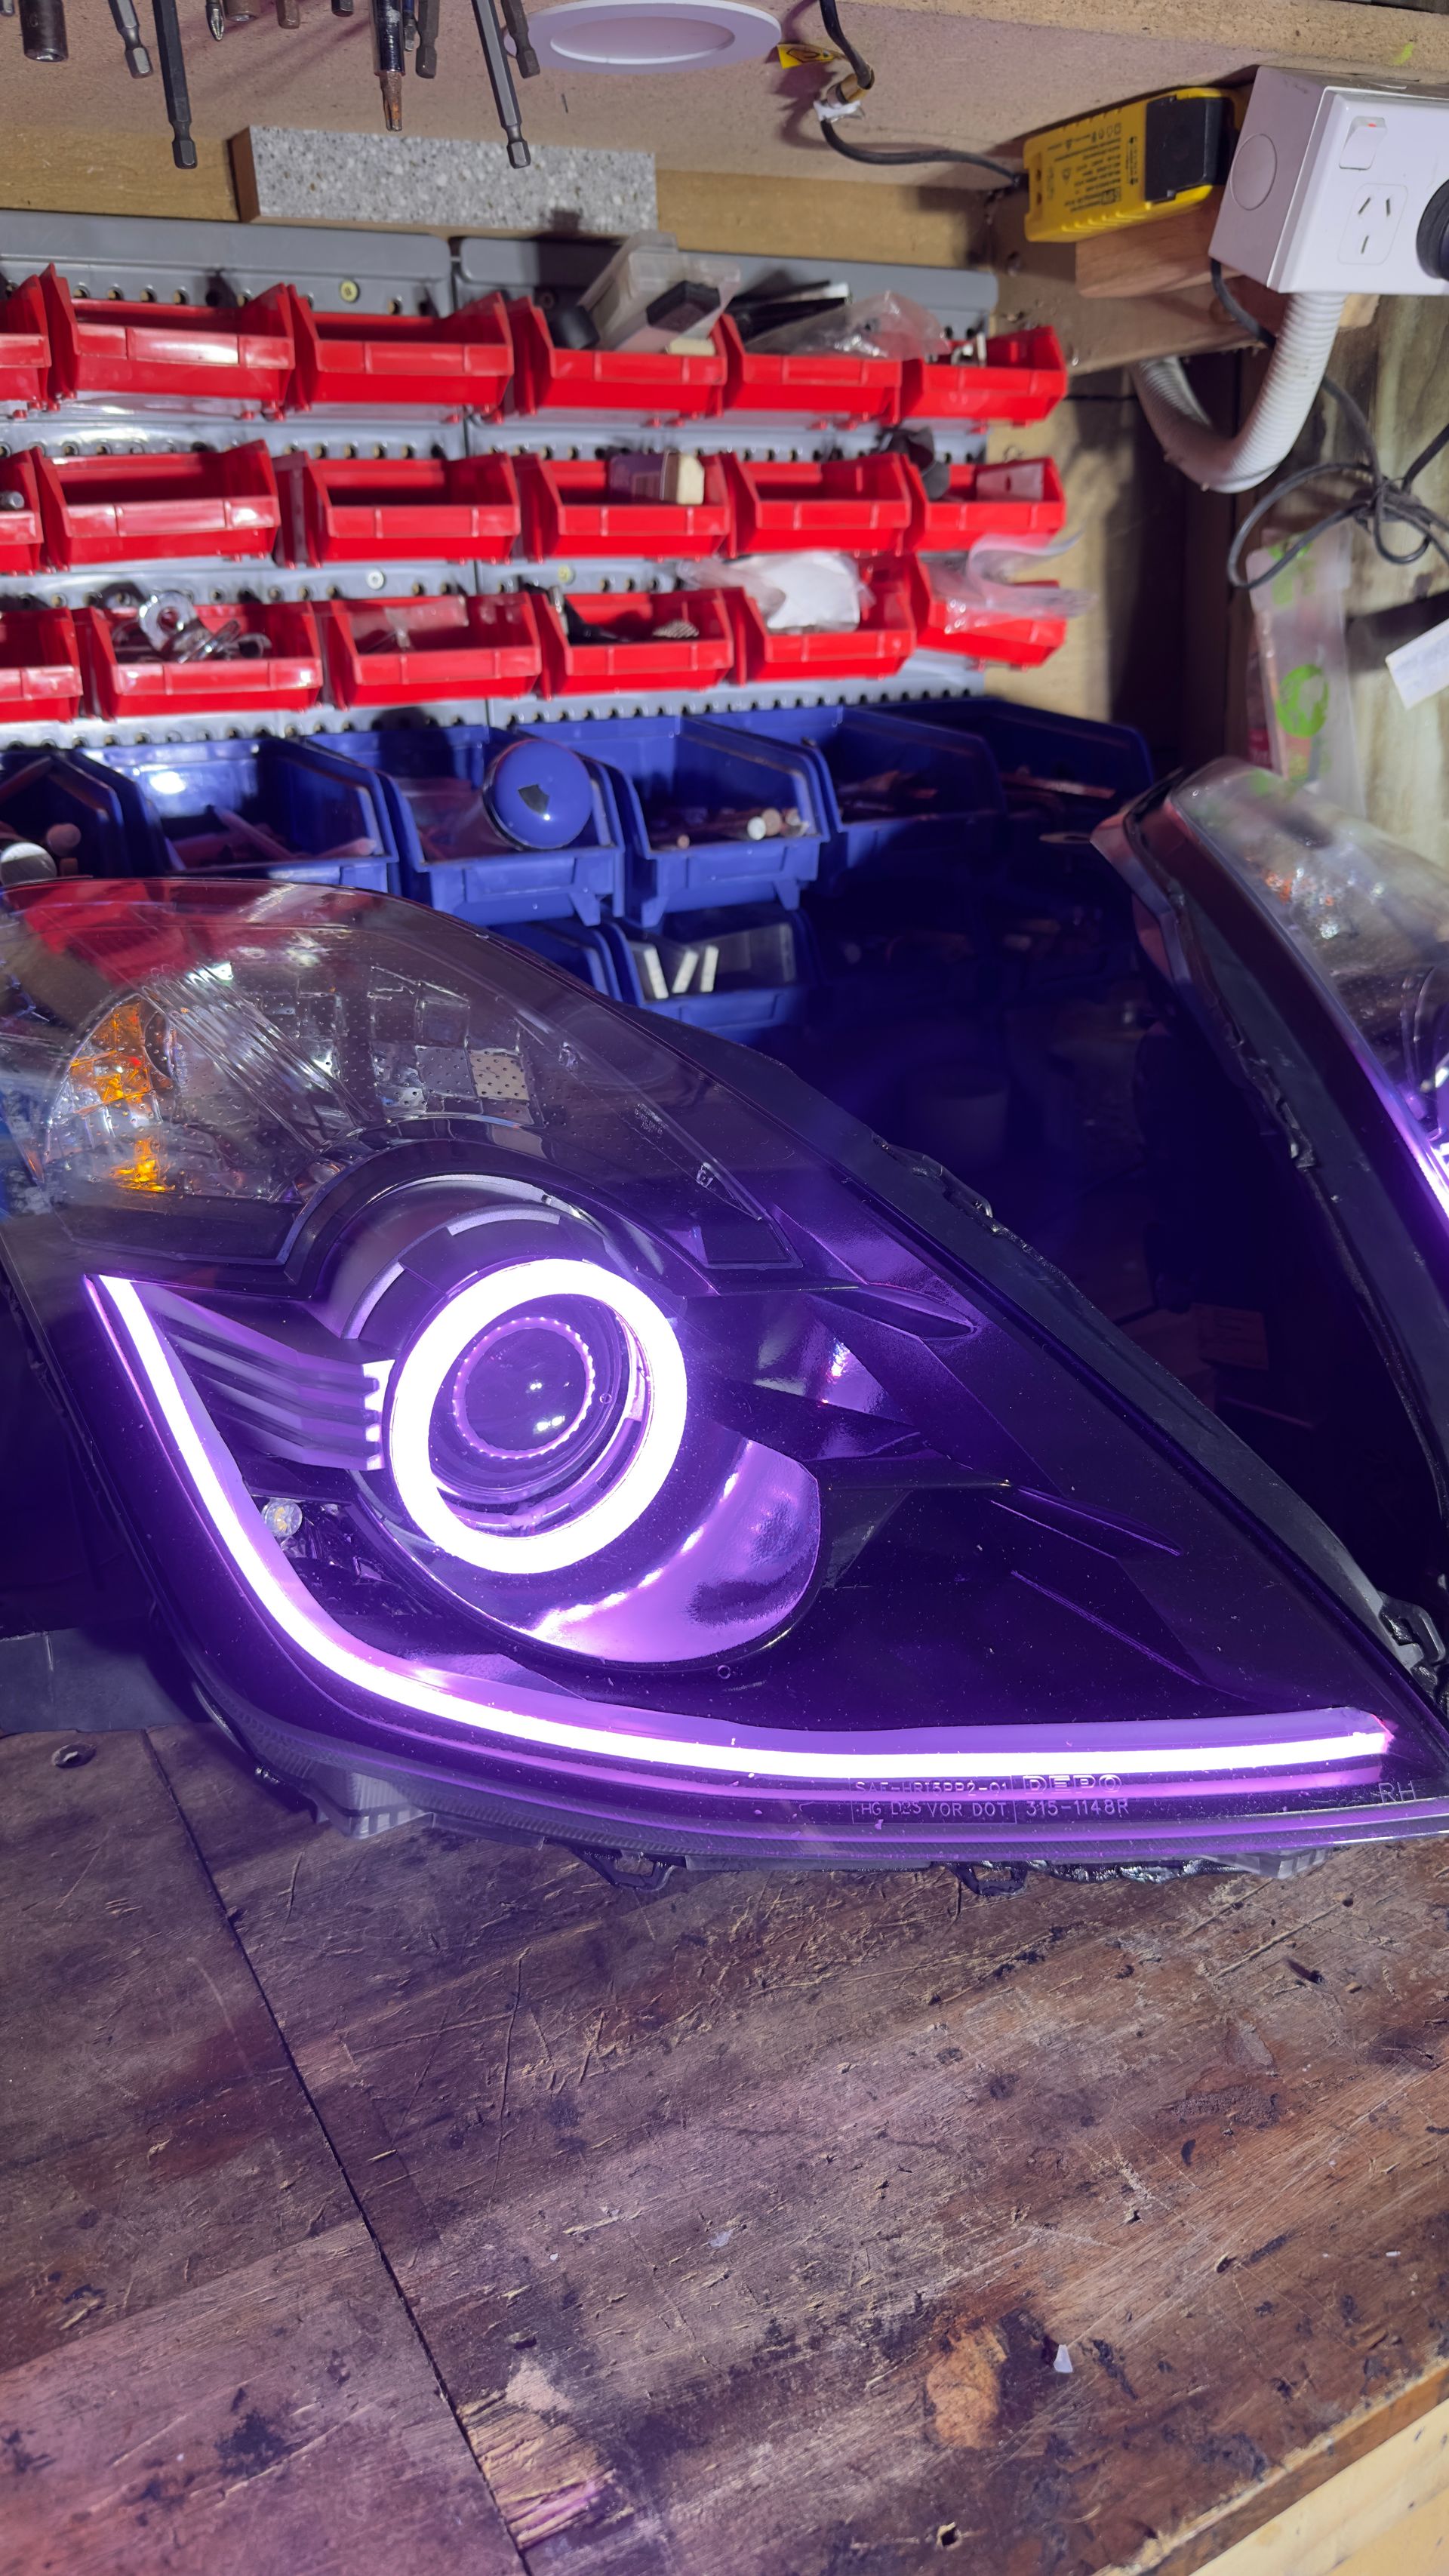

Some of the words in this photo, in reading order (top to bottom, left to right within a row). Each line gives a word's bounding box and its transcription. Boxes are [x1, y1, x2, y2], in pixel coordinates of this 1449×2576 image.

[1023, 1774, 1123, 1794] DEPO
[1378, 1780, 1416, 1805] RH
[927, 1802, 963, 1817] VOR
[972, 1802, 1007, 1817] DOT
[1026, 1799, 1130, 1816] 315-1148R
